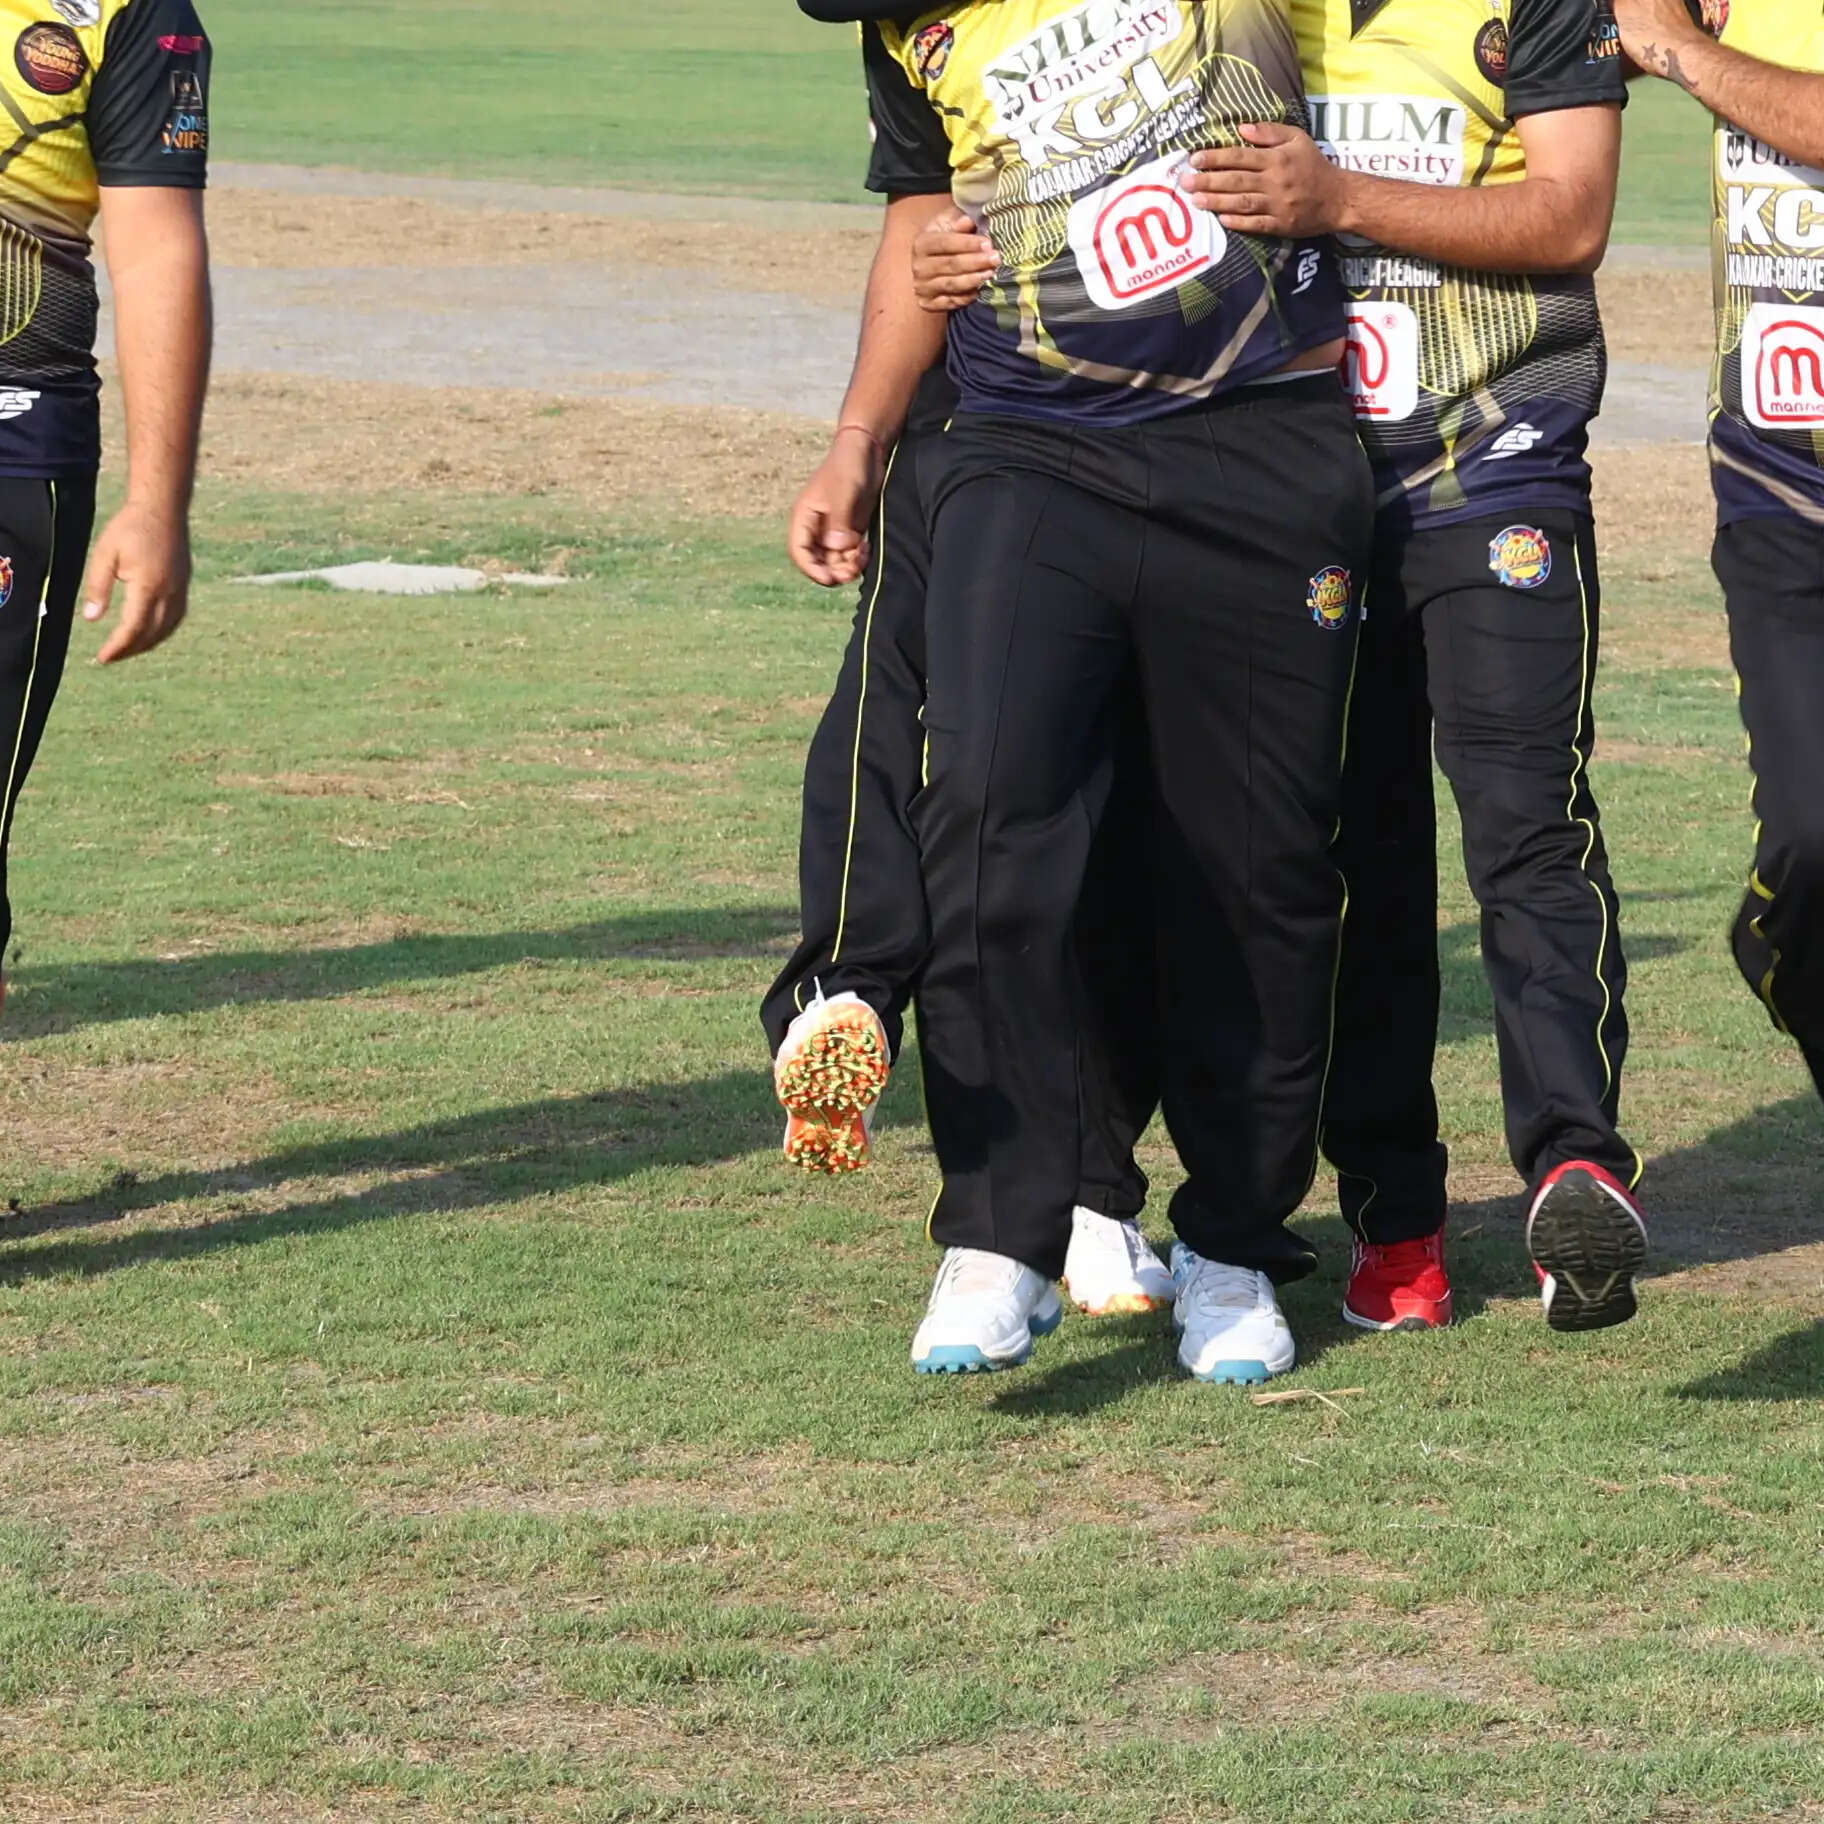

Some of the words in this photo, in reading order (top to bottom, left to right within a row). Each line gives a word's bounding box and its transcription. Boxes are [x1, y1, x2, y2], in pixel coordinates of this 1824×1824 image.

[1007, 57, 1195, 171] KCL
[1309, 102, 1459, 146] IILM
[1028, 156, 1096, 204] KALAKAR
[1318, 145, 1456, 184] niversity
[1386, 257, 1442, 288] LEAGUE
